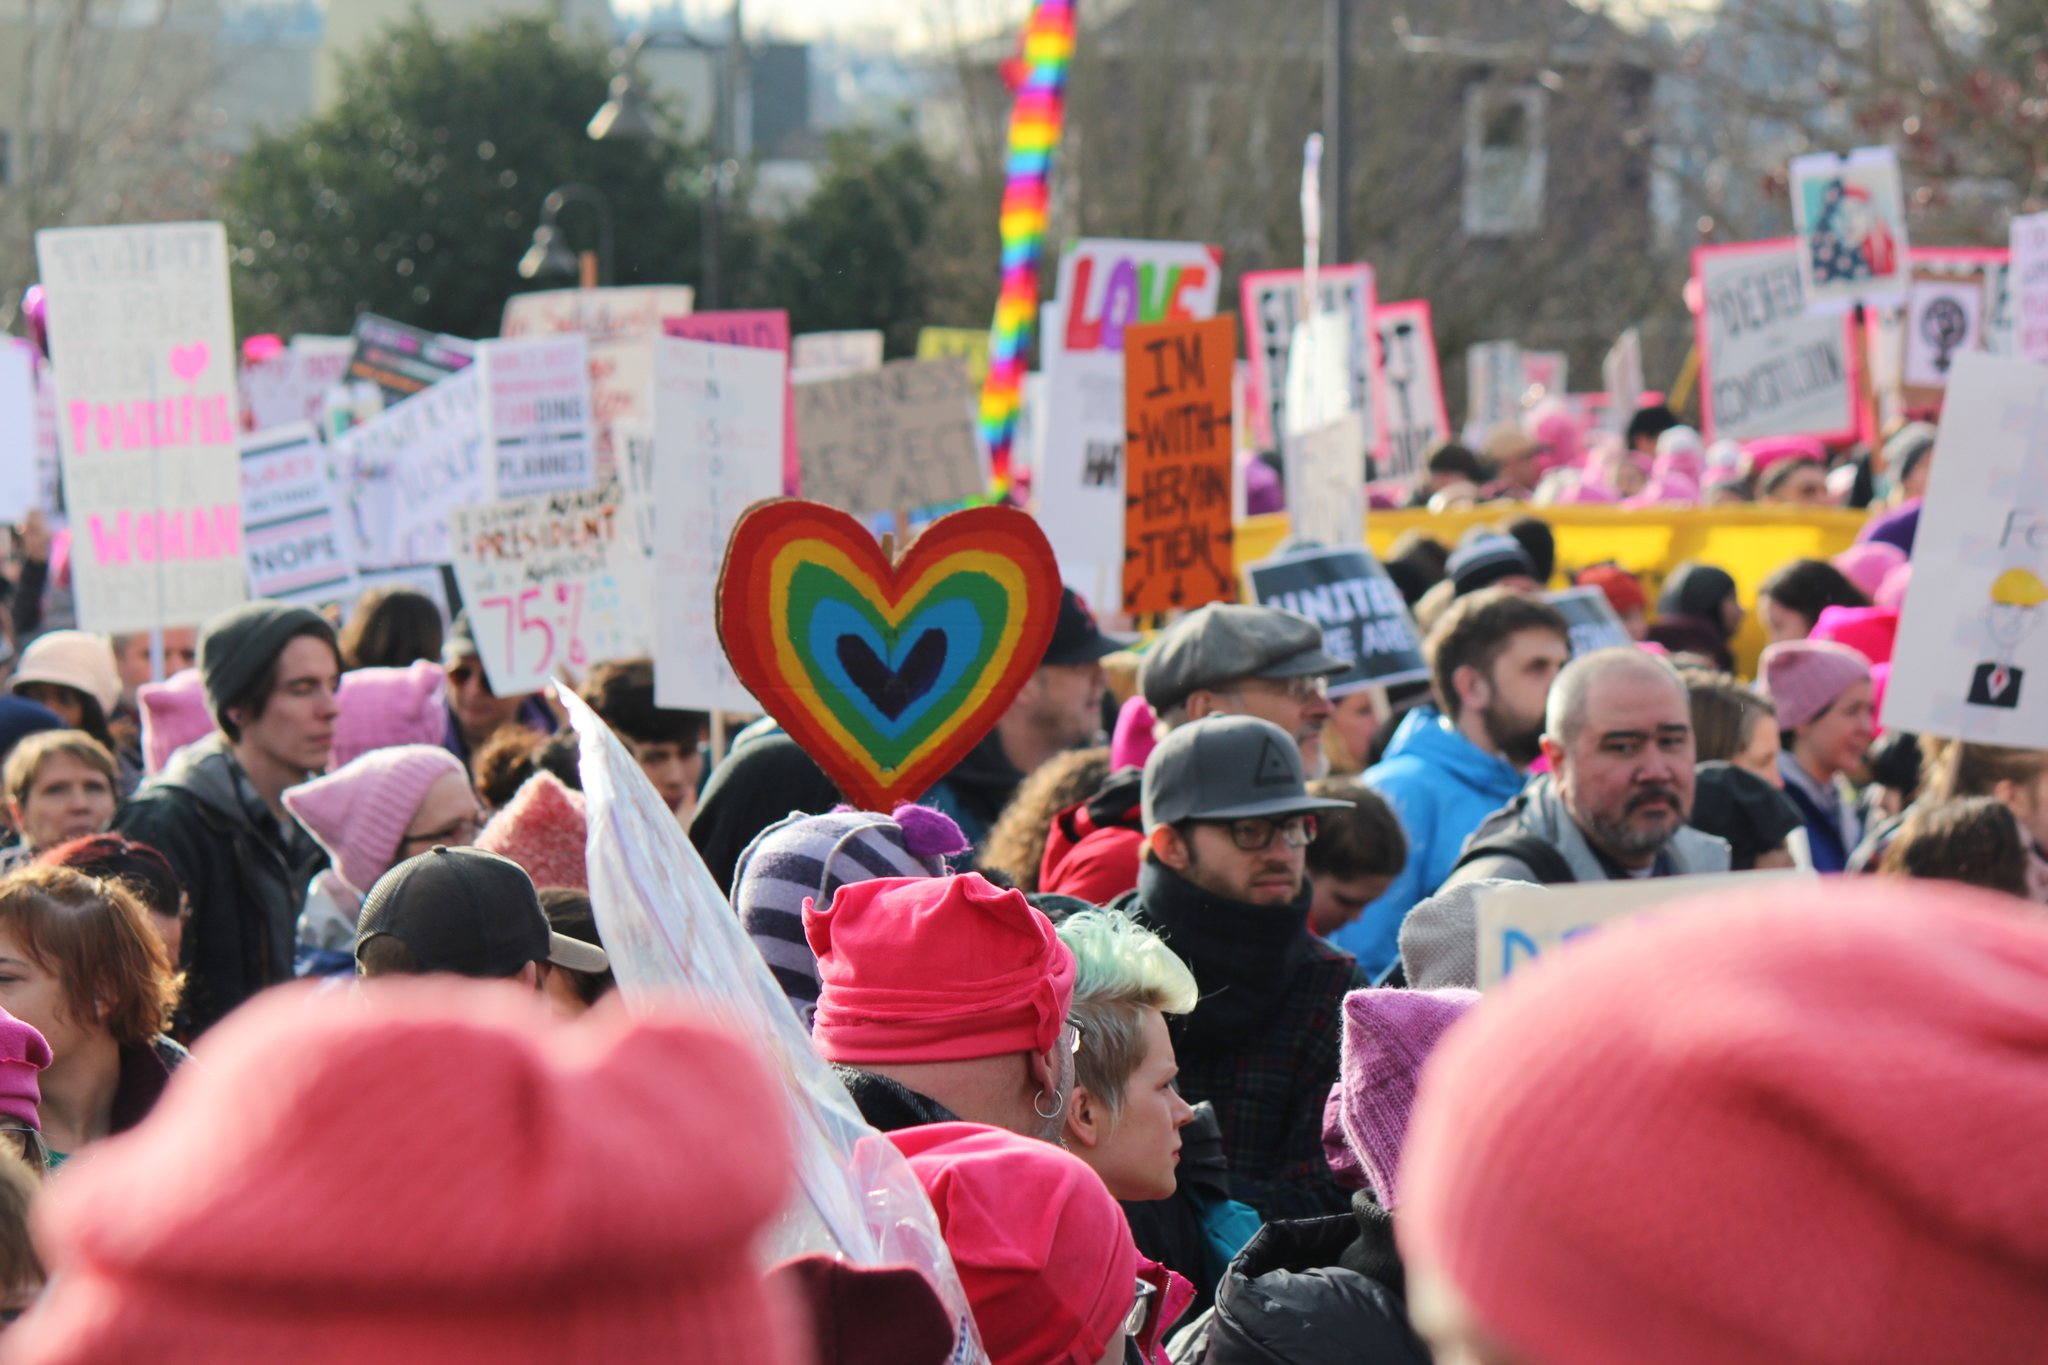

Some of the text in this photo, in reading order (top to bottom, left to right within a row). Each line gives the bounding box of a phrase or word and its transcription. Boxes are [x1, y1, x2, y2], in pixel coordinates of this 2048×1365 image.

[1064, 254, 1207, 352] LOVE
[1139, 402, 1217, 459] WITH
[88, 503, 241, 566] WOMAN
[248, 530, 336, 577] NOPE
[479, 582, 588, 677] 75%
[1266, 575, 1405, 626] UNITE
